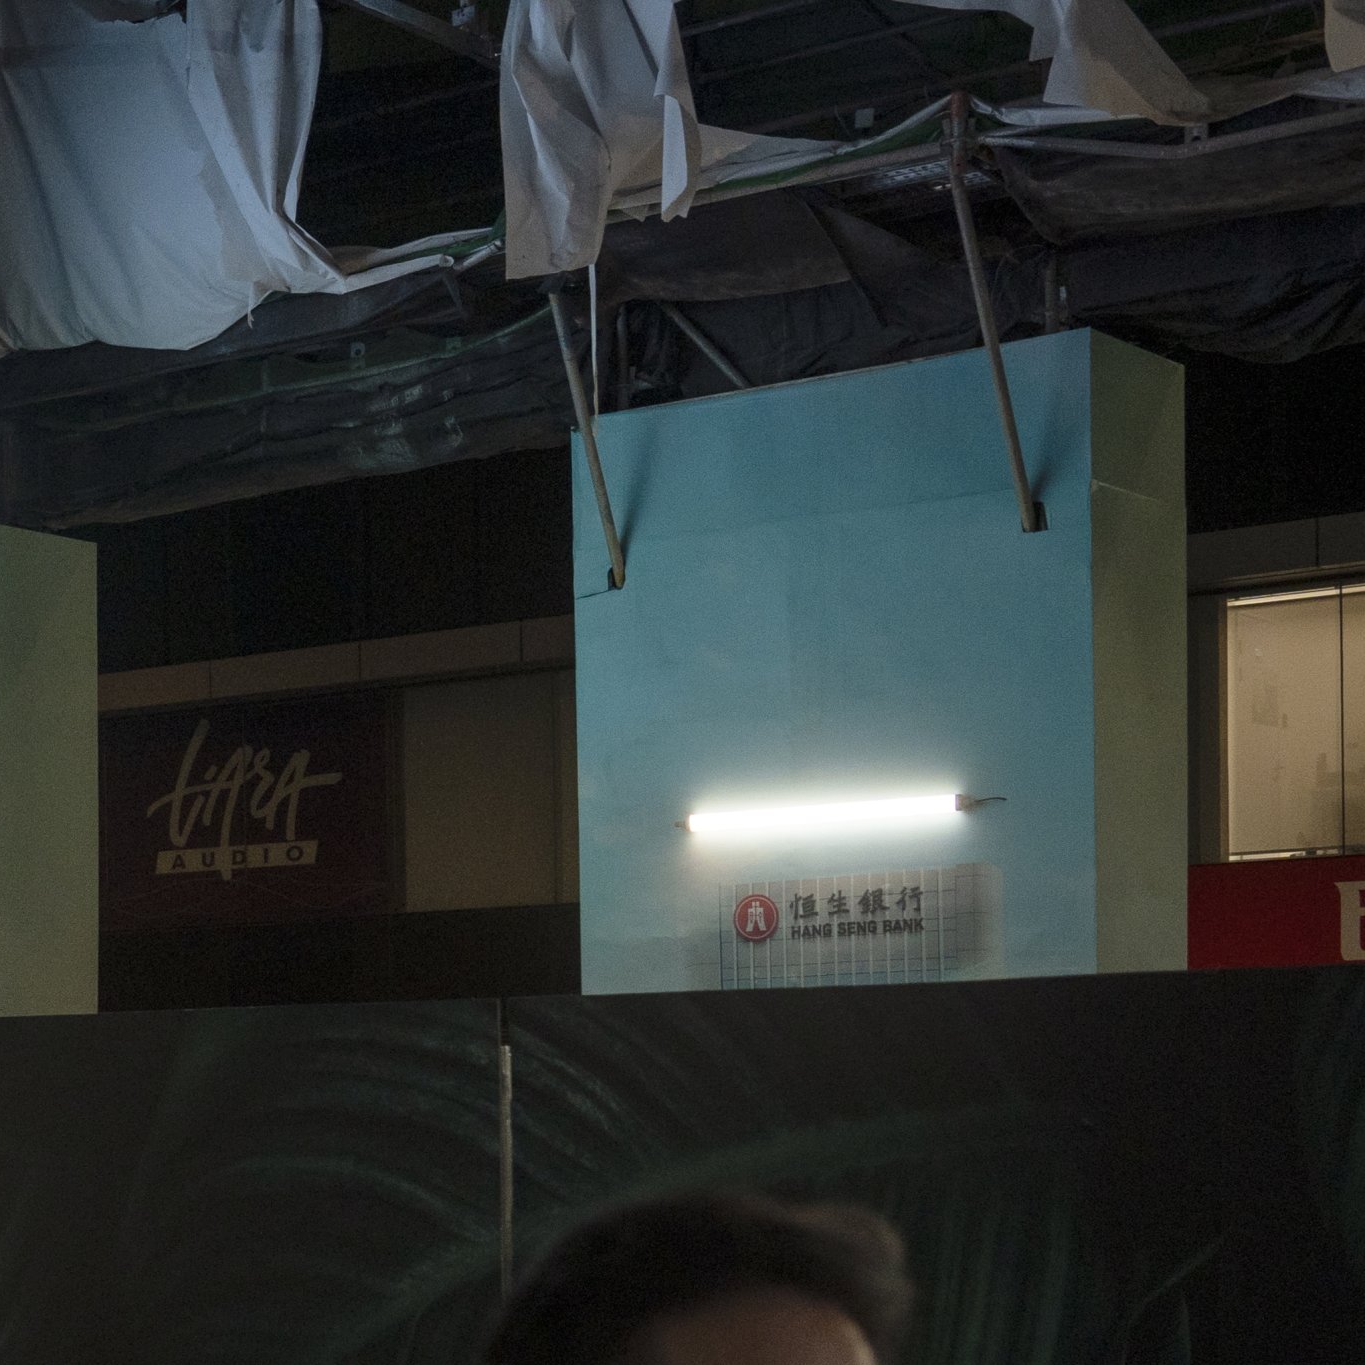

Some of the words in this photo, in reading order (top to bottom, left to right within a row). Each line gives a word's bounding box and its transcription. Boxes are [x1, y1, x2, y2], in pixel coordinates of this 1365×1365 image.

[172, 846, 305, 870] AUDIO
[789, 885, 925, 921] 恒生銀行
[791, 922, 832, 940] HANG
[836, 919, 877, 937] SENG
[882, 916, 925, 933] BANK
